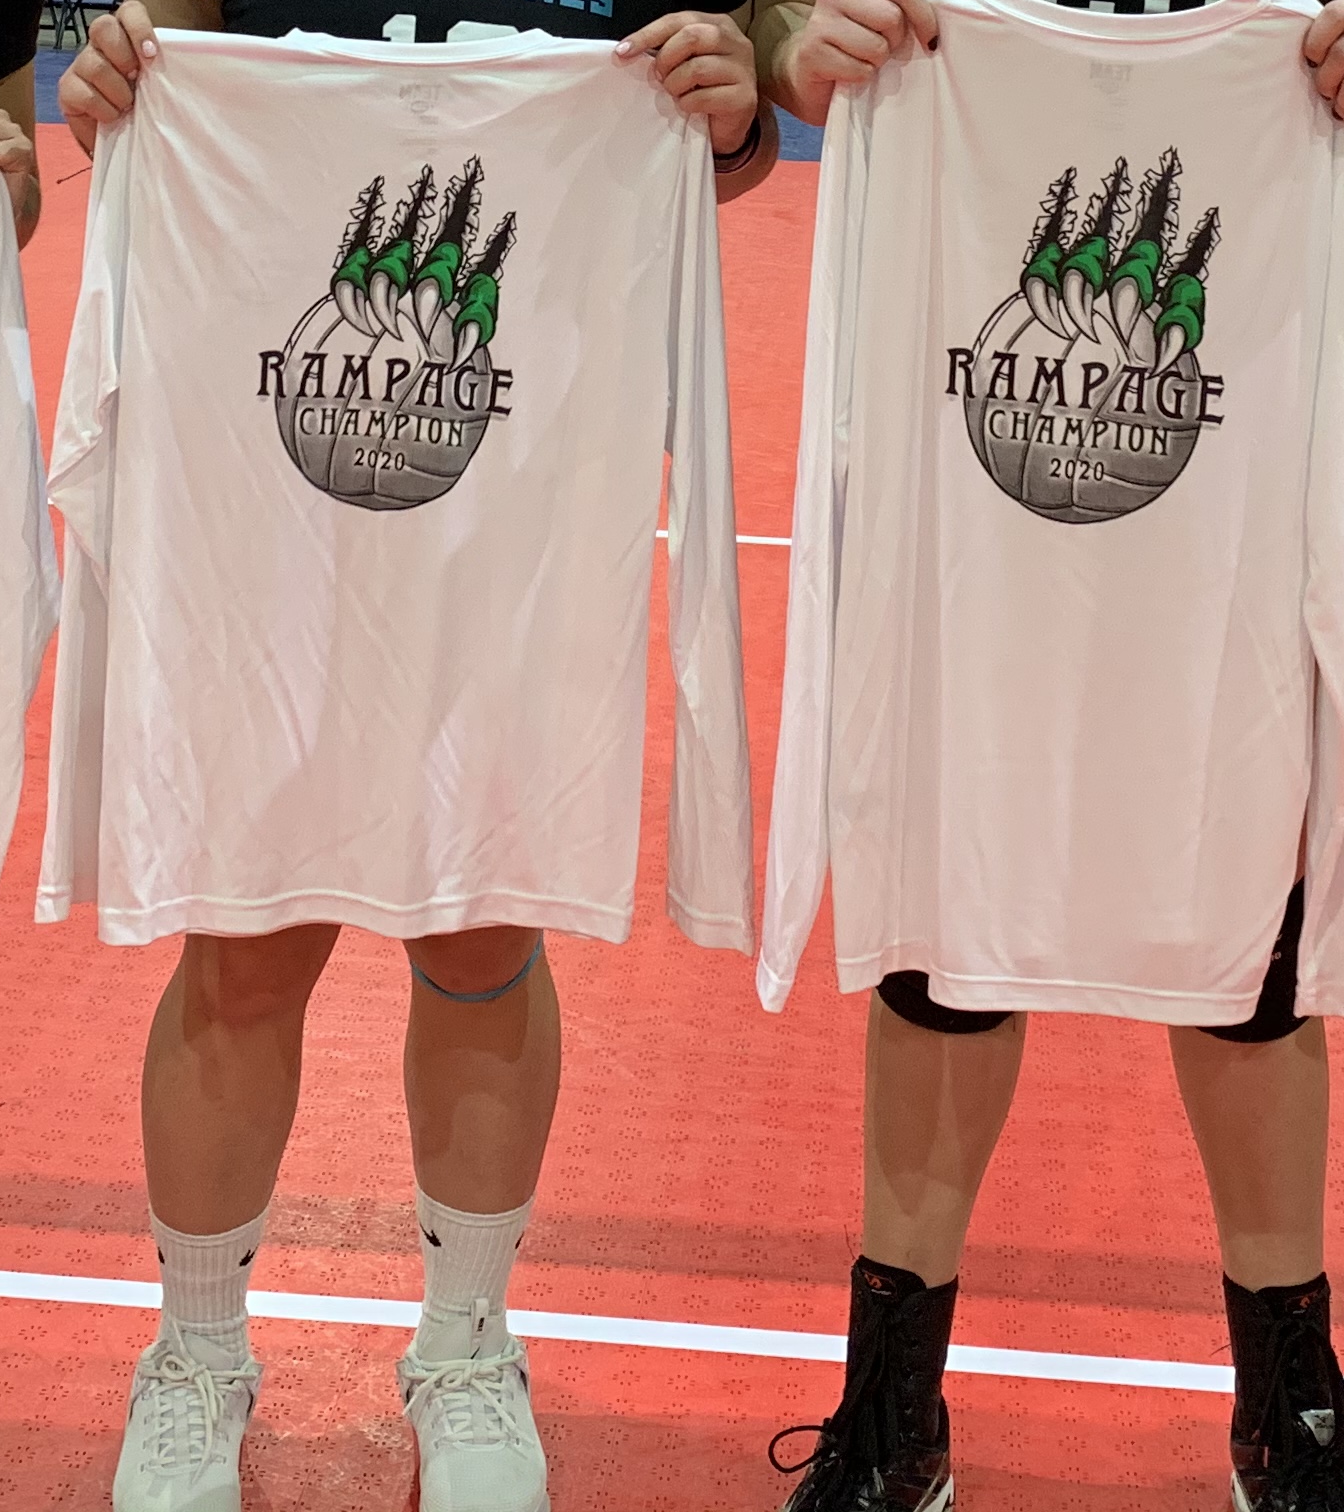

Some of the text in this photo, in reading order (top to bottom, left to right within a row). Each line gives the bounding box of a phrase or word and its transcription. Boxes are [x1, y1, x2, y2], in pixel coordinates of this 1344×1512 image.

[257, 350, 514, 416] RAMPAGE
[945, 348, 1225, 424] RAMPAGE
[299, 407, 465, 447] CHAMPION
[989, 409, 1171, 456] CHAMPION
[354, 447, 405, 471] 2020
[1050, 458, 1105, 481] 2020
